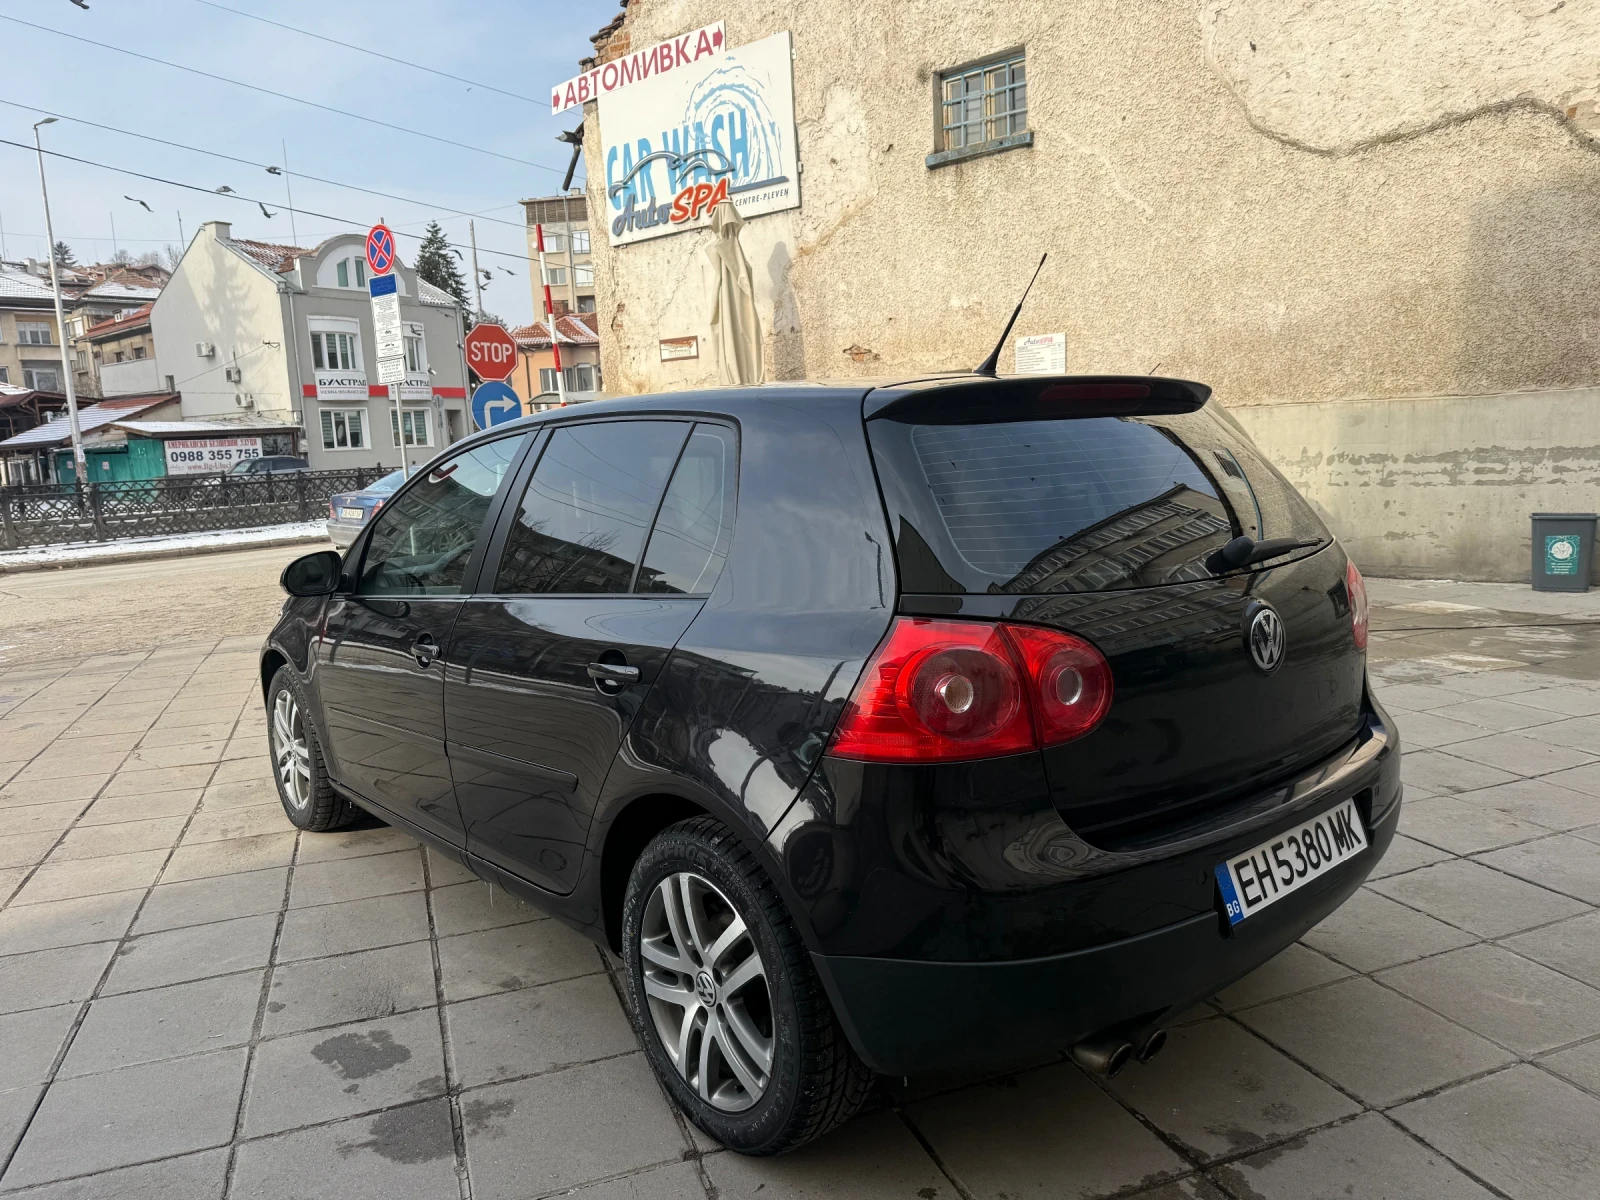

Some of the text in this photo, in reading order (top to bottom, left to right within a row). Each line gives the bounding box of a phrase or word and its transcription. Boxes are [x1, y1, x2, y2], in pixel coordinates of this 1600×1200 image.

[563, 29, 714, 109] АВТОМИВКА
[606, 108, 749, 211] CAR WASH
[735, 188, 789, 206] CENTRE-PLEVEN
[471, 341, 512, 363] STOP
[170, 448, 259, 462] 0988 355 755
[1226, 901, 1240, 917] BG
